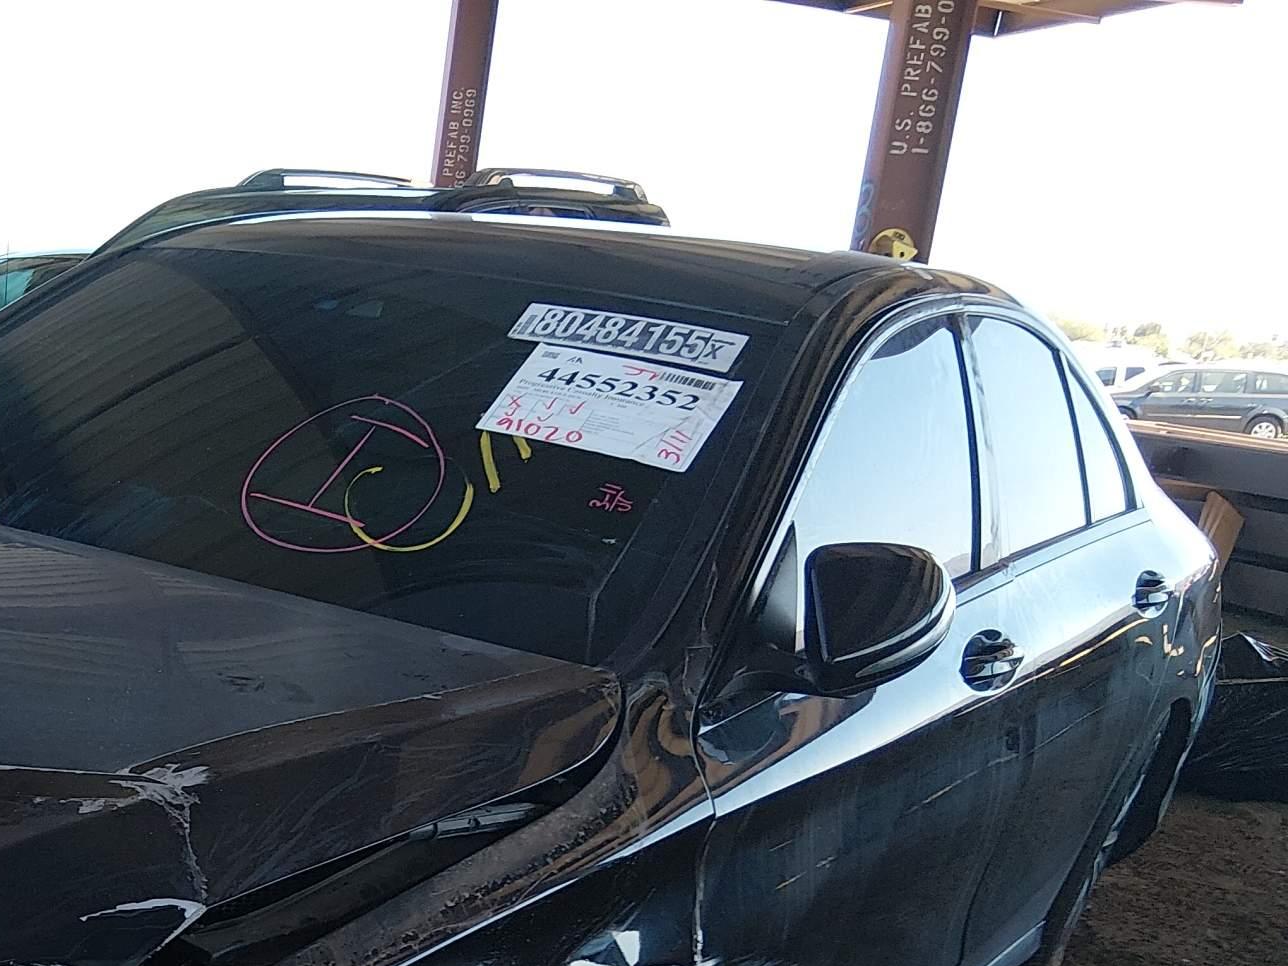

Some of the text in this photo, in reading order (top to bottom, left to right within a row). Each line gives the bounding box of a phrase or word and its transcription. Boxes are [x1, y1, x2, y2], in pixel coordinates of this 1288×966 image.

[889, 4, 932, 155] U.S. PREFAB
[442, 87, 465, 177] PREFAB INC.
[538, 367, 700, 411] 44552352
